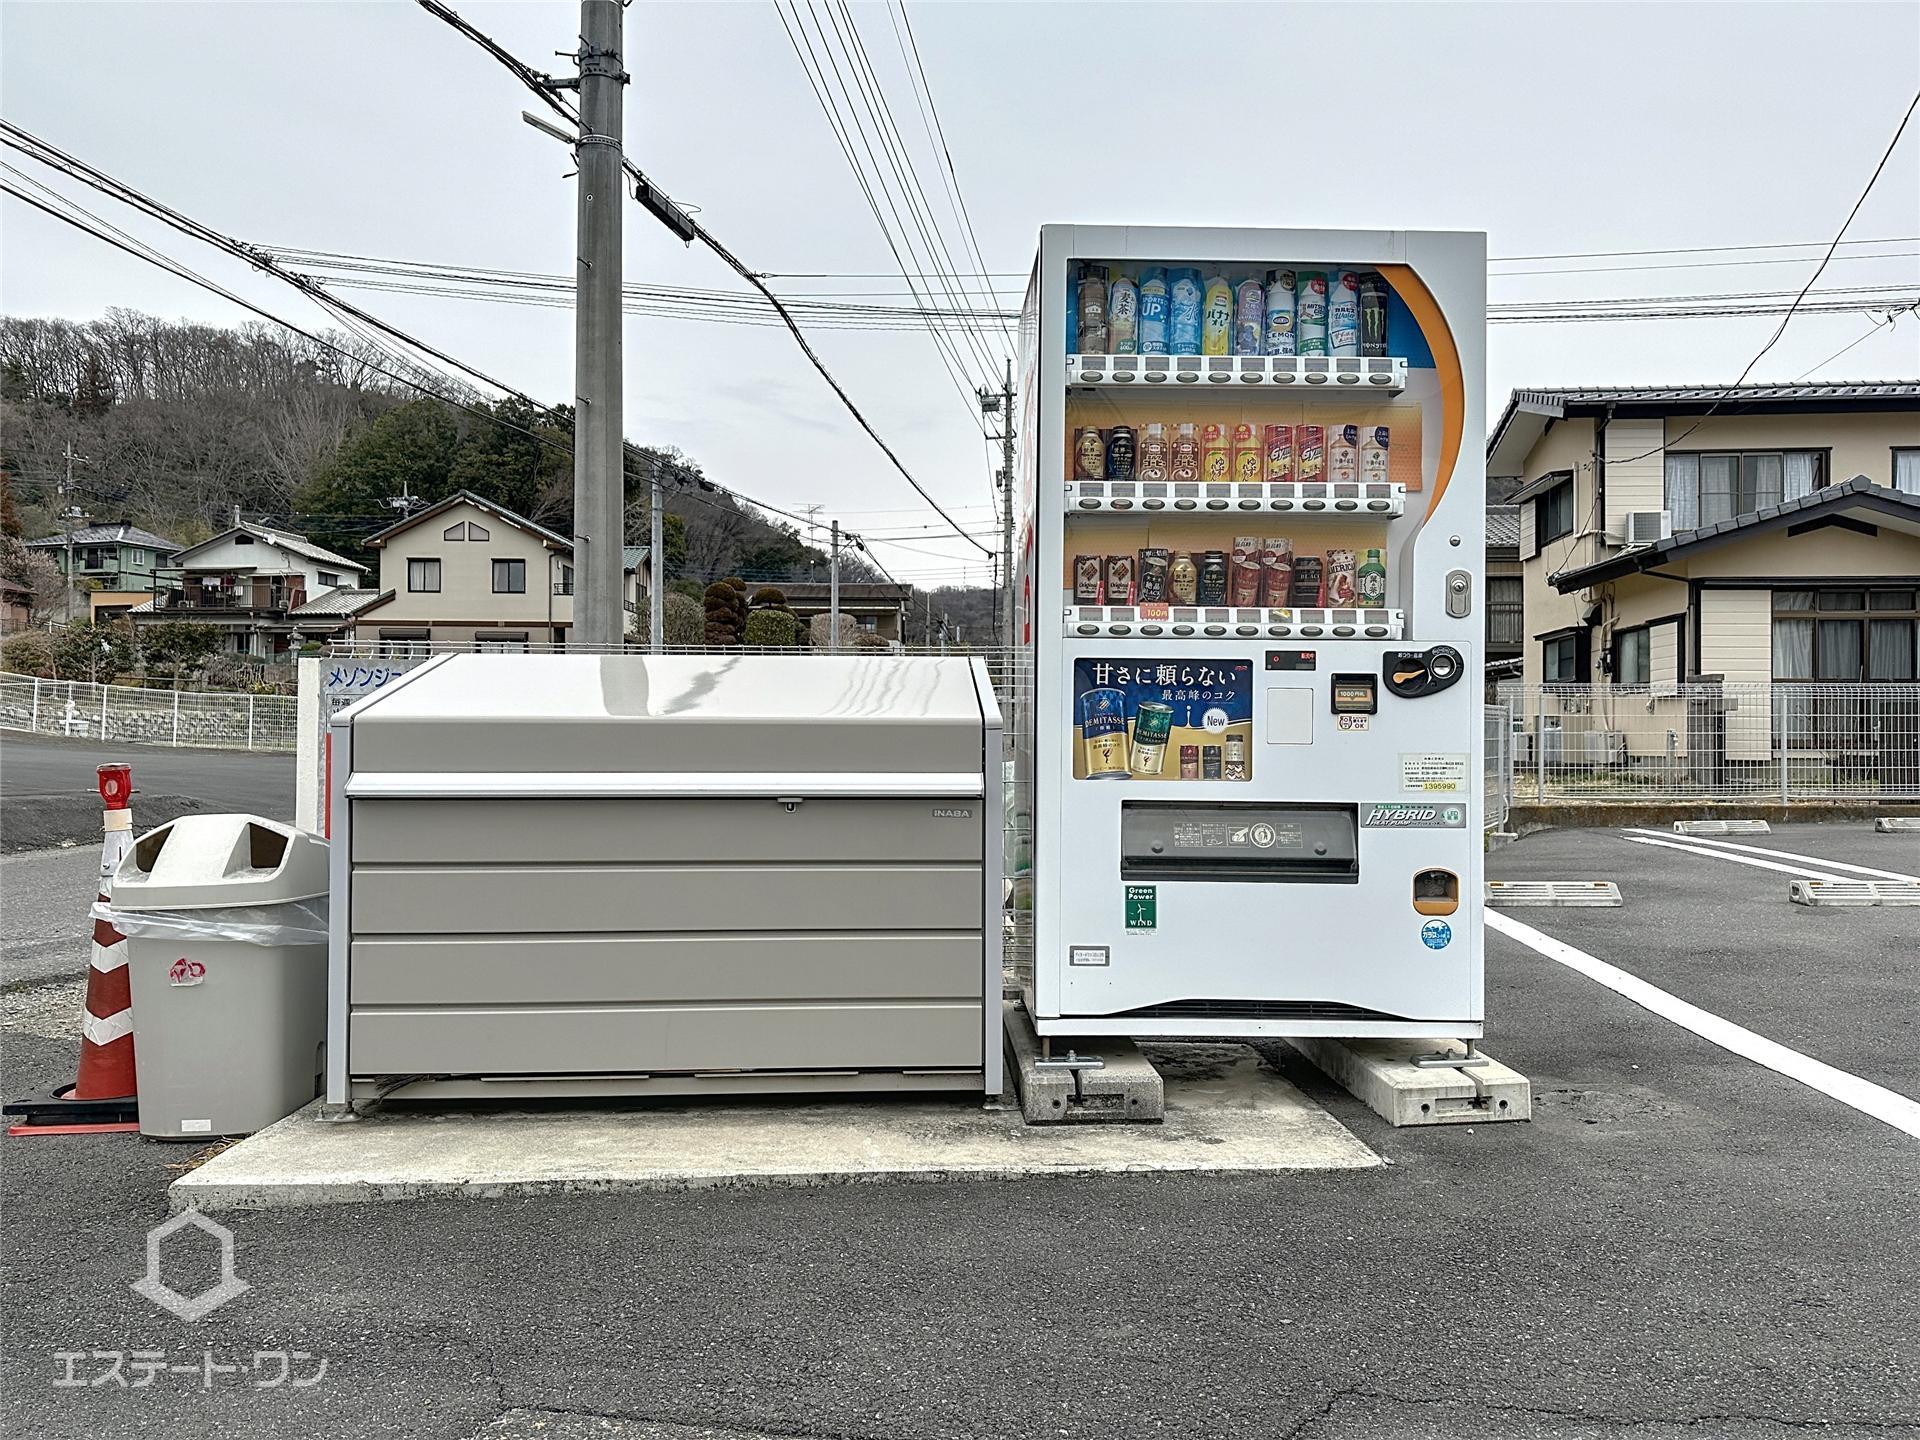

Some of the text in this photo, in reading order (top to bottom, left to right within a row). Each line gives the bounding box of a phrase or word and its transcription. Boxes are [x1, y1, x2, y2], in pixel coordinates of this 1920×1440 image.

[1117, 288, 1132, 315] 麦茶
[1142, 303, 1161, 316] UP
[1183, 304, 1199, 321] 水
[1207, 309, 1230, 320] バナナ
[1266, 331, 1295, 340] LEMON
[1093, 663, 1236, 686] 甘さに頼らない
[1162, 689, 1236, 701] 最高峰のコク
[1085, 716, 1124, 728] DEMITASSE
[1207, 715, 1225, 726] New
[934, 809, 970, 818] INABA
[1366, 809, 1437, 825] HYBRID
